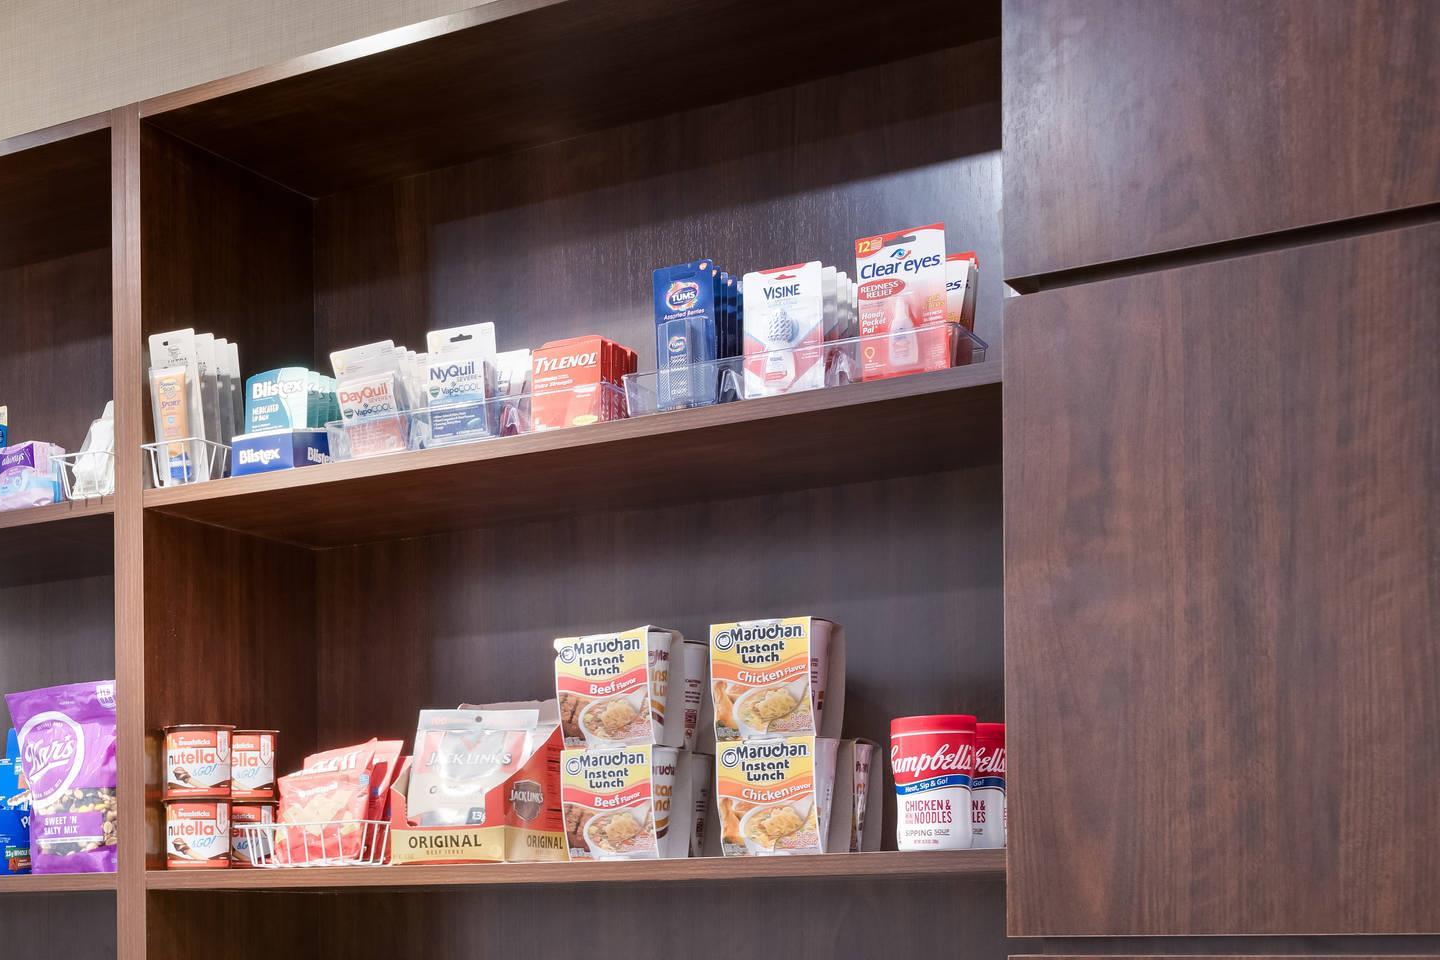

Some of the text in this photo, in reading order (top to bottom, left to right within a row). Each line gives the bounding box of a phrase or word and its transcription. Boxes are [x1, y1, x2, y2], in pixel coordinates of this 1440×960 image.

[860, 254, 941, 280] Clear eyes
[763, 283, 801, 300] VISINE
[860, 281, 900, 294] REDNESS
[866, 289, 893, 299] RELIEF
[671, 291, 696, 303] TUMS
[534, 352, 597, 374] TYLENOL
[430, 361, 475, 383] NyQuil
[252, 379, 305, 400] Blistex
[339, 383, 389, 404] DayQuil
[1, 453, 25, 466] always
[239, 448, 281, 465] Blistex
[730, 624, 802, 642] Maruchan
[573, 638, 640, 655] Maruchan
[736, 641, 785, 654] Instant
[579, 654, 625, 667] Instant
[741, 652, 780, 664] Lunch
[584, 664, 620, 677] Lunch
[737, 663, 807, 683] Chicken Flavor
[589, 677, 637, 695] Beef Flavor
[168, 749, 215, 766] nutella
[736, 743, 807, 759] Maruchan
[427, 753, 465, 766] JACK
[579, 751, 644, 767] Maruchan
[741, 759, 790, 772] Instant
[584, 767, 629, 779] Instant
[746, 770, 785, 782] Lunch
[589, 778, 625, 789] Lunch
[919, 781, 930, 790] Sip
[936, 777, 949, 786] Go!
[594, 791, 641, 807] Beef Flavor
[742, 783, 812, 801] Chicken Flavor
[905, 799, 951, 812] CHICKEN &
[45, 817, 67, 826] SWEET
[914, 811, 953, 824] NOODLES
[44, 824, 78, 835] SALTY MIX
[168, 821, 215, 837] nutella
[905, 829, 933, 837] SIPPING
[408, 834, 482, 849] ORIGINAL
[526, 835, 563, 850] ORIGINAL
